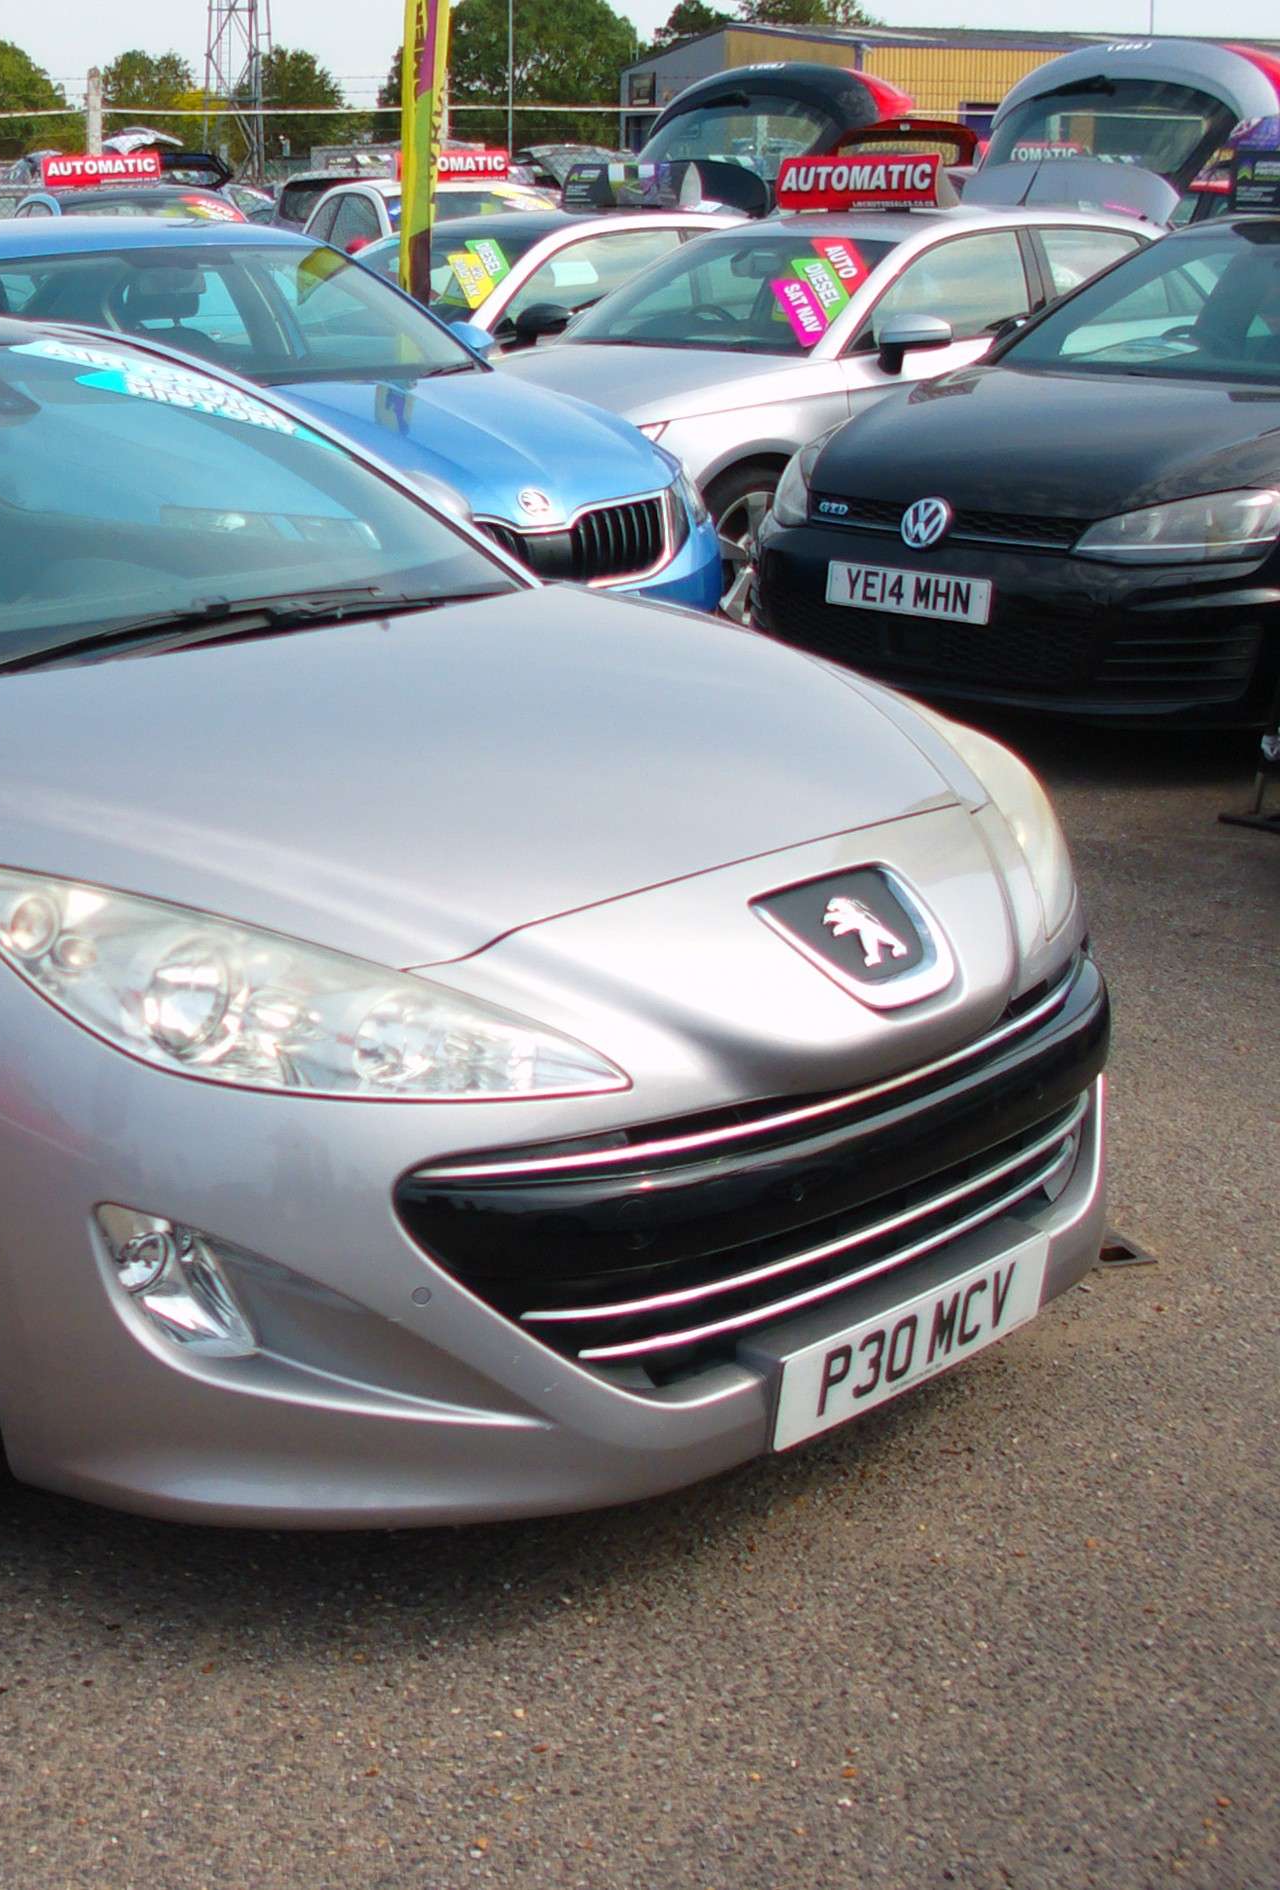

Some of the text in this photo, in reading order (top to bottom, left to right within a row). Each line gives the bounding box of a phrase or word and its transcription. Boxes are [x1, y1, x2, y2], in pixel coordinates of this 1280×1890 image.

[47, 157, 156, 177] AUTOMATIC
[437, 155, 506, 172] OMATIC
[780, 163, 933, 192] AUTOMATIC
[824, 245, 858, 279] AUTO
[803, 262, 841, 309] DIESEL
[783, 283, 823, 333] SAT NAV
[847, 567, 972, 615] YE14 MHN
[816, 1262, 1016, 1418] P30 MCV
